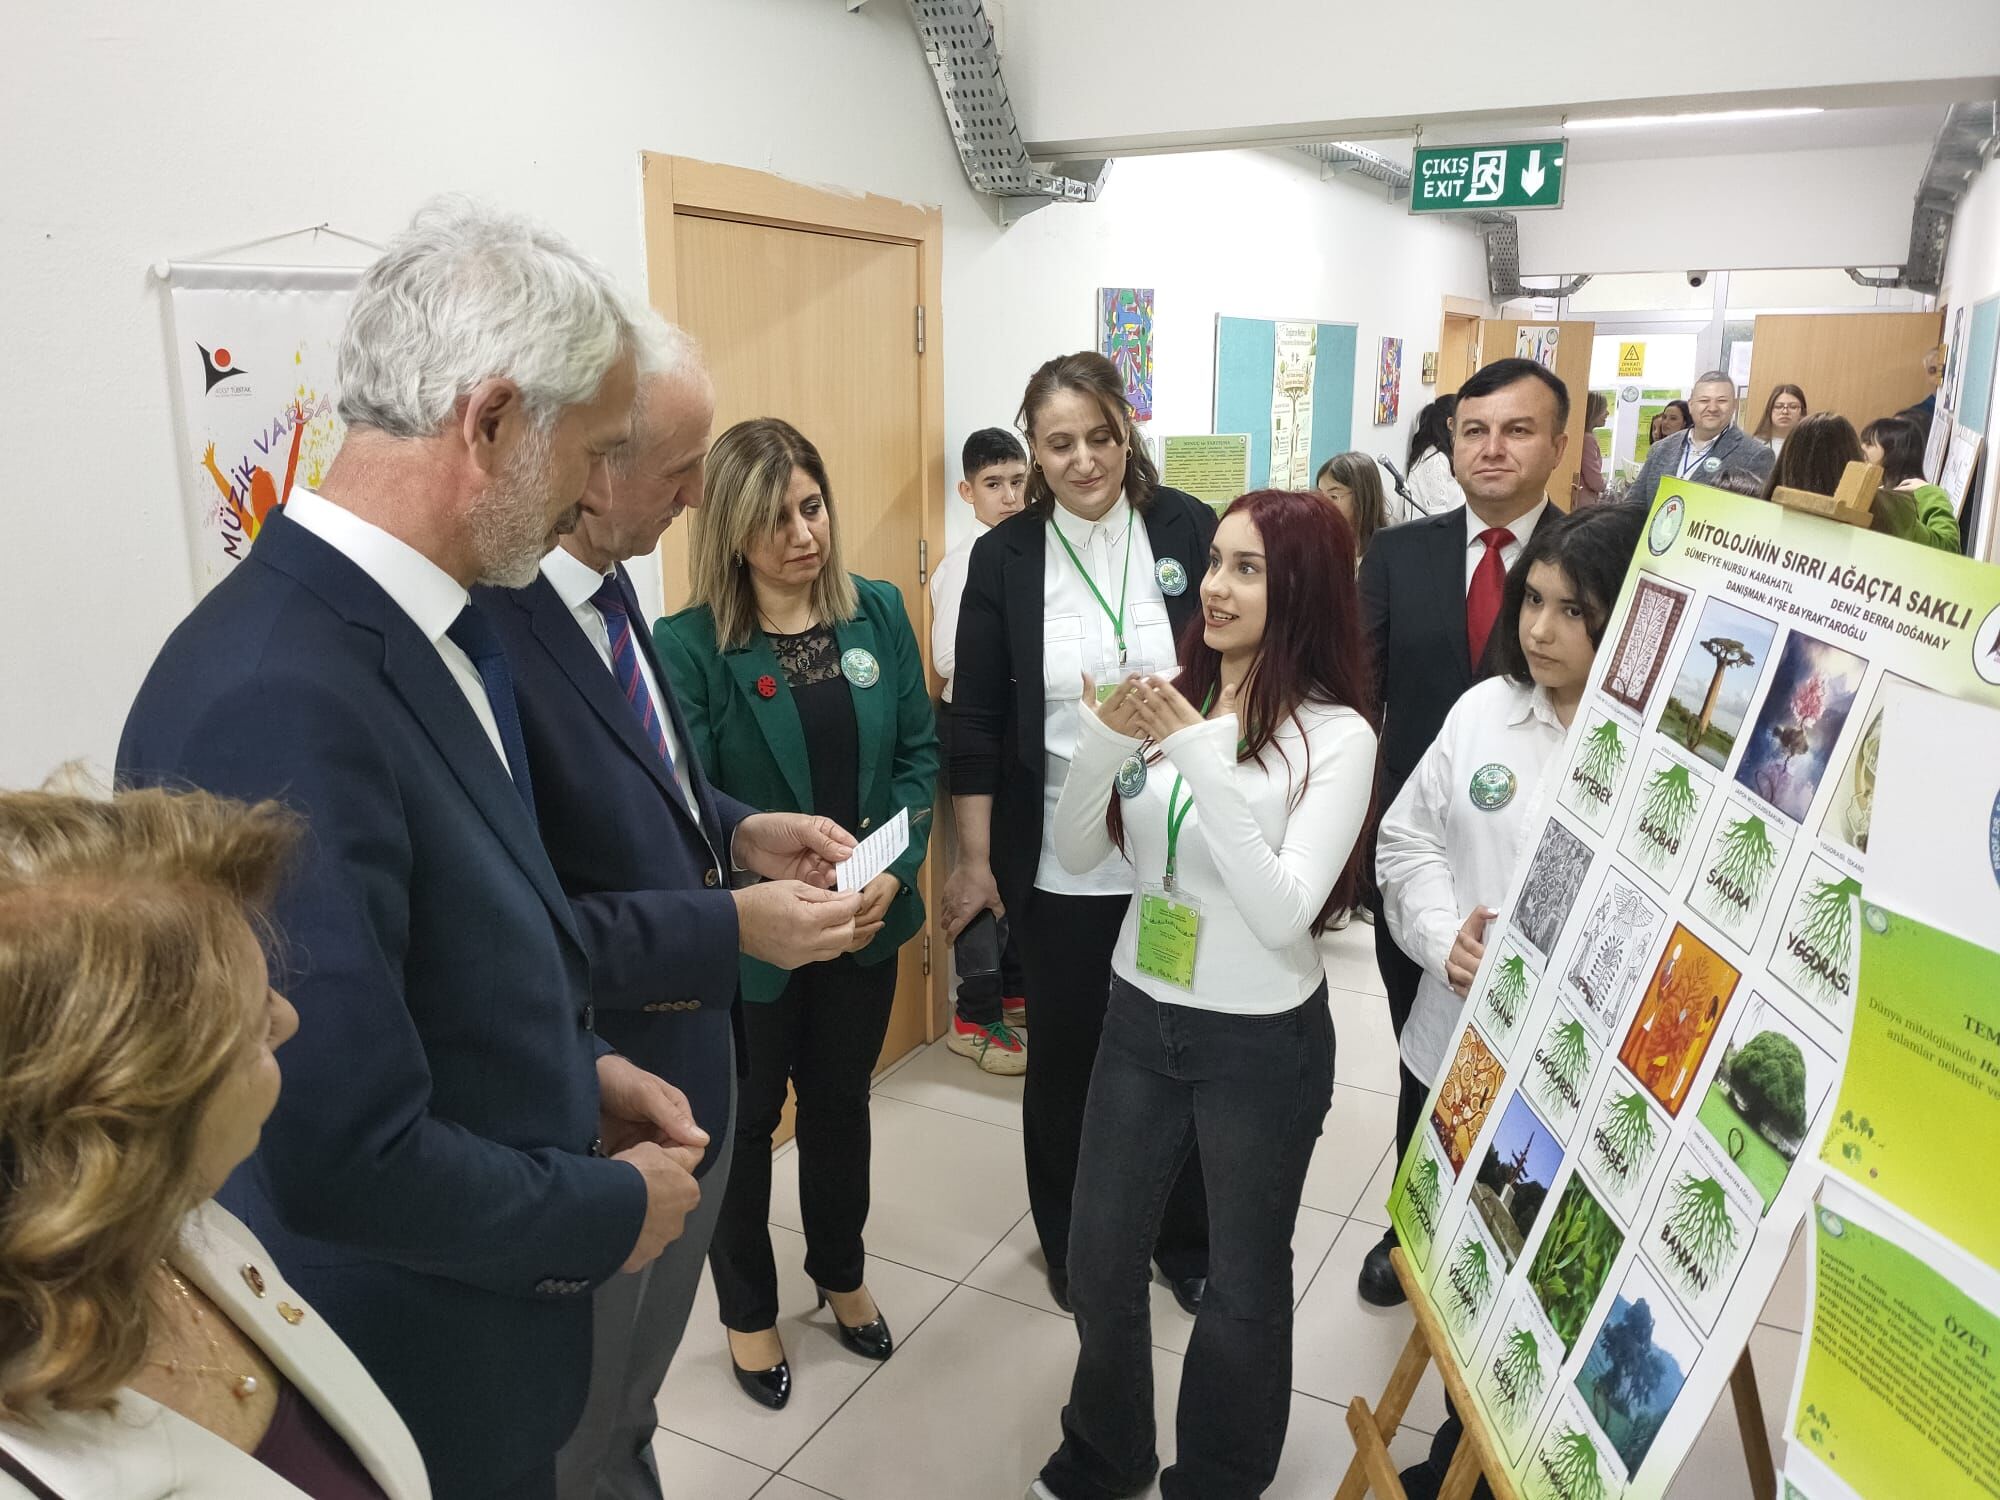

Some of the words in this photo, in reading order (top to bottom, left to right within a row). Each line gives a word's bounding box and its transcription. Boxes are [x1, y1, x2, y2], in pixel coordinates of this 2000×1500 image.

[1422, 157, 1469, 179] ÇIKIŞ
[1424, 180, 1464, 198] EXIT
[221, 455, 256, 560] MÜZİK
[254, 394, 332, 455] VARSA
[1684, 547, 1721, 571] SÜMEYYE
[1722, 559, 1748, 577] NURSU
[1749, 567, 1793, 594] KARAHATIL
[1687, 519, 1781, 565] MİTOLOJİNİN
[1781, 550, 1827, 581] SIRRI
[1827, 565, 1902, 607] AĞAÇTA
[1905, 590, 1974, 631] SAKLI
[1766, 593, 1788, 613] AYŞE
[1788, 600, 1868, 643] BAYRAKTAROĞLU
[1830, 598, 1860, 618] DENİZ
[1862, 609, 1894, 631] BERRA
[1896, 618, 1951, 651] DOĞANAY
[1572, 767, 1613, 807] BAYTEREK
[1639, 817, 1680, 856] BAOBAB
[1706, 869, 1750, 912] SAKURA
[1869, 997, 1903, 1025] Dünya
[1905, 1018, 1977, 1066] mitolojisinde
[1886, 1028, 1936, 1062] anlamlar
[1937, 1057, 1984, 1091] nelerdir
[1593, 1127, 1630, 1181] PERSEA
[1944, 1311, 1991, 1359] ÖZET
